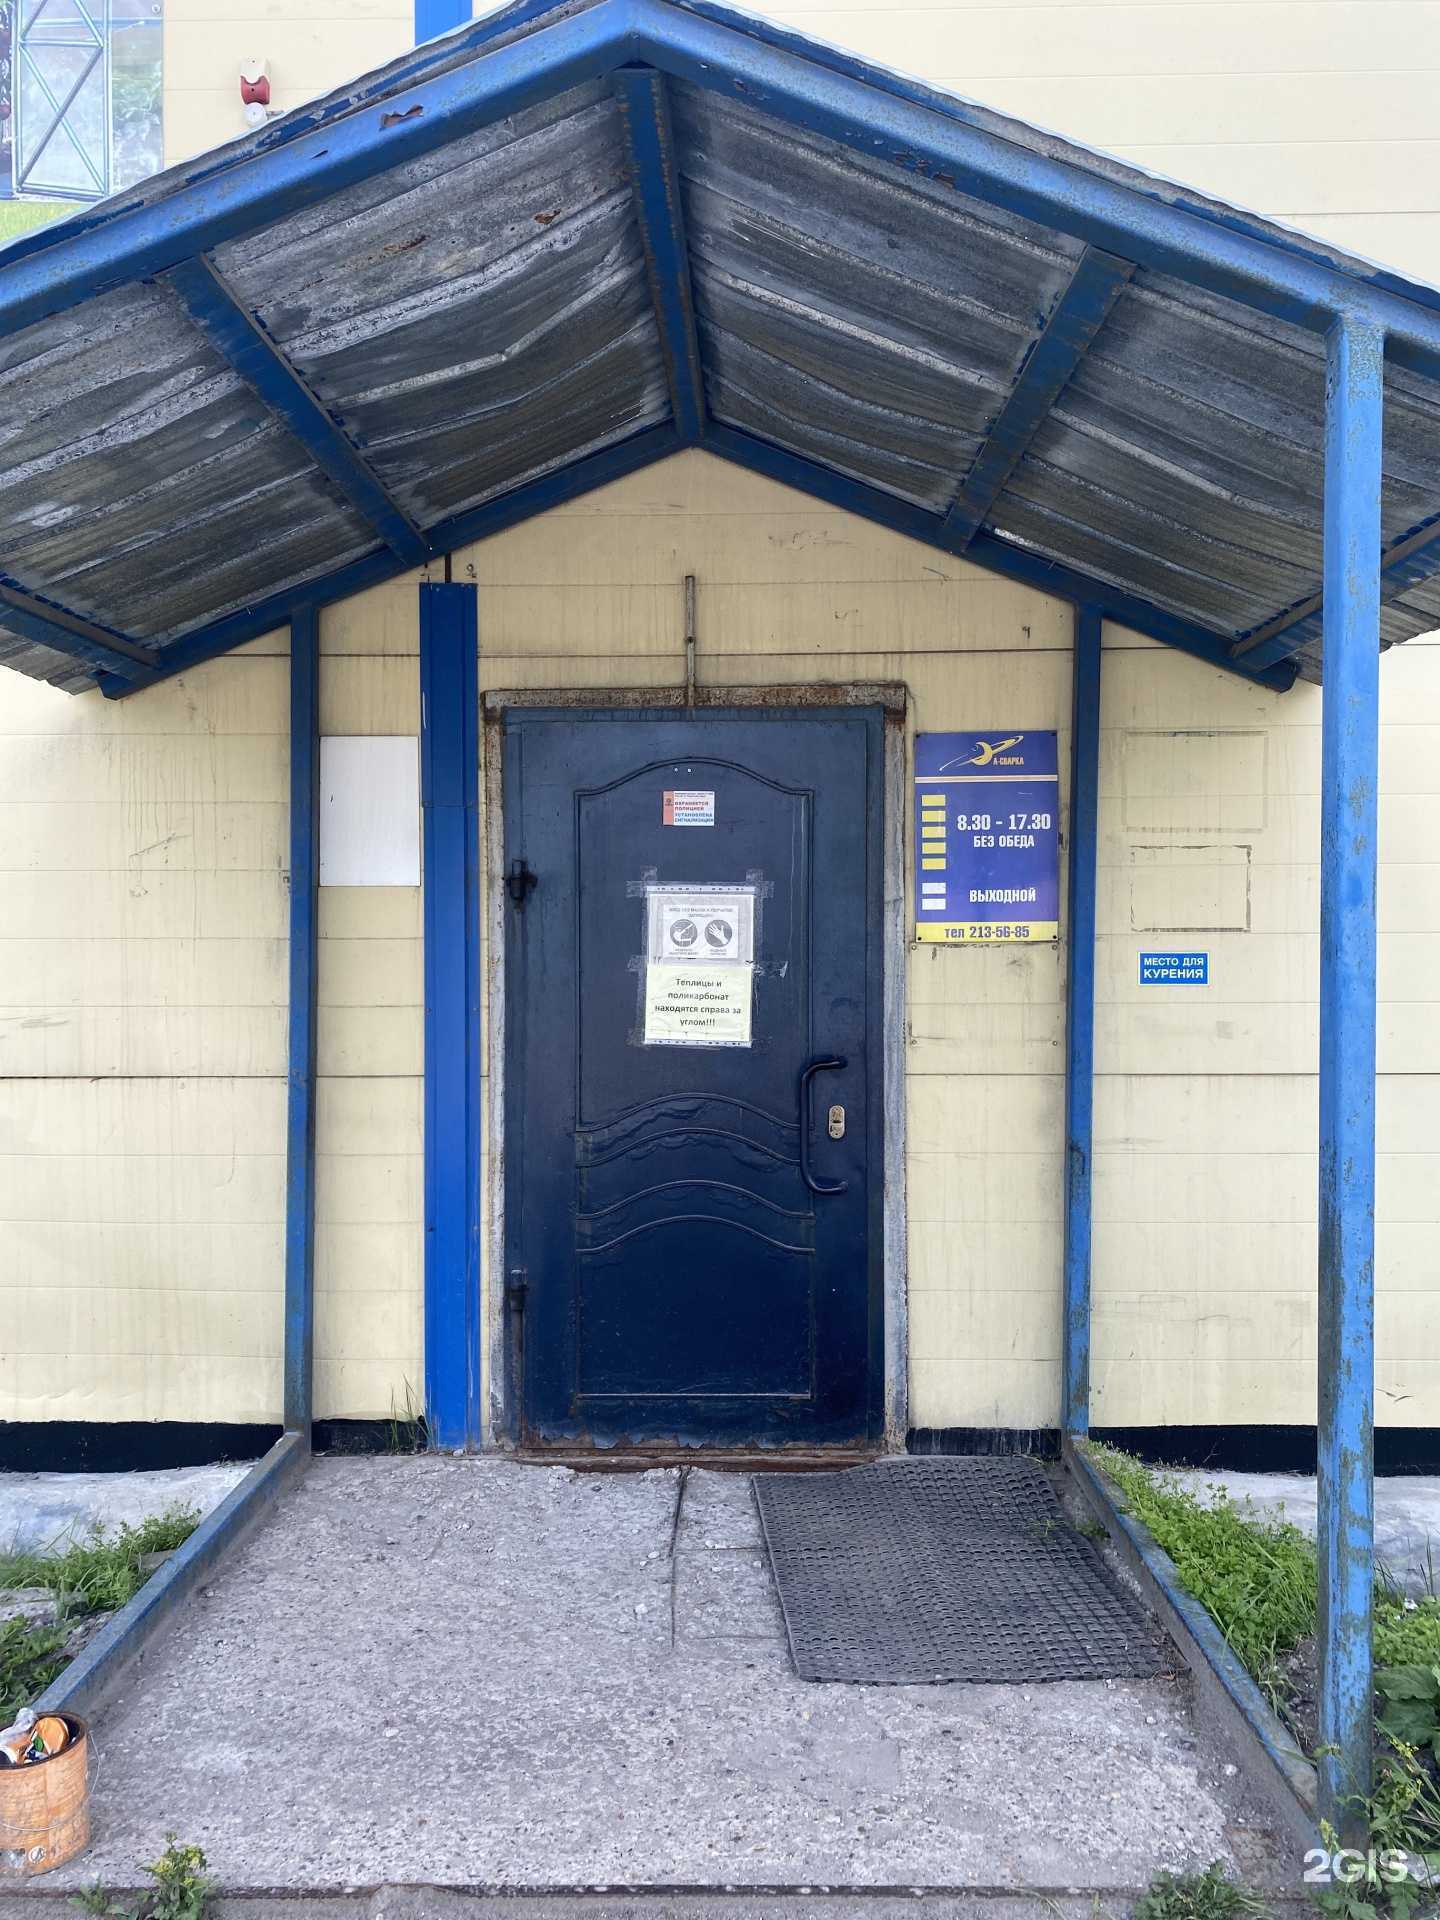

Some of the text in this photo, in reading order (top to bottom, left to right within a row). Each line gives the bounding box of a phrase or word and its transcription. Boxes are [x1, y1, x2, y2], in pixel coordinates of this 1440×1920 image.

[957, 814, 991, 831] 8.30
[1008, 813, 1051, 830] 17.30
[973, 835, 1035, 849] БЕЗ ОБЕДА
[969, 887, 1037, 904] ВЫХОДНОЙ
[945, 925, 1030, 939] тел 213-56-85
[1143, 957, 1204, 967] МЕСТО ДЛЯ
[1143, 968, 1204, 979] КУРЕНИЯ
[676, 978, 714, 988] Теплицы
[667, 992, 729, 1001] поликарбонат
[655, 1004, 699, 1014] находятся
[700, 1006, 730, 1014] справа
[680, 1018, 716, 1027] углом!!!
